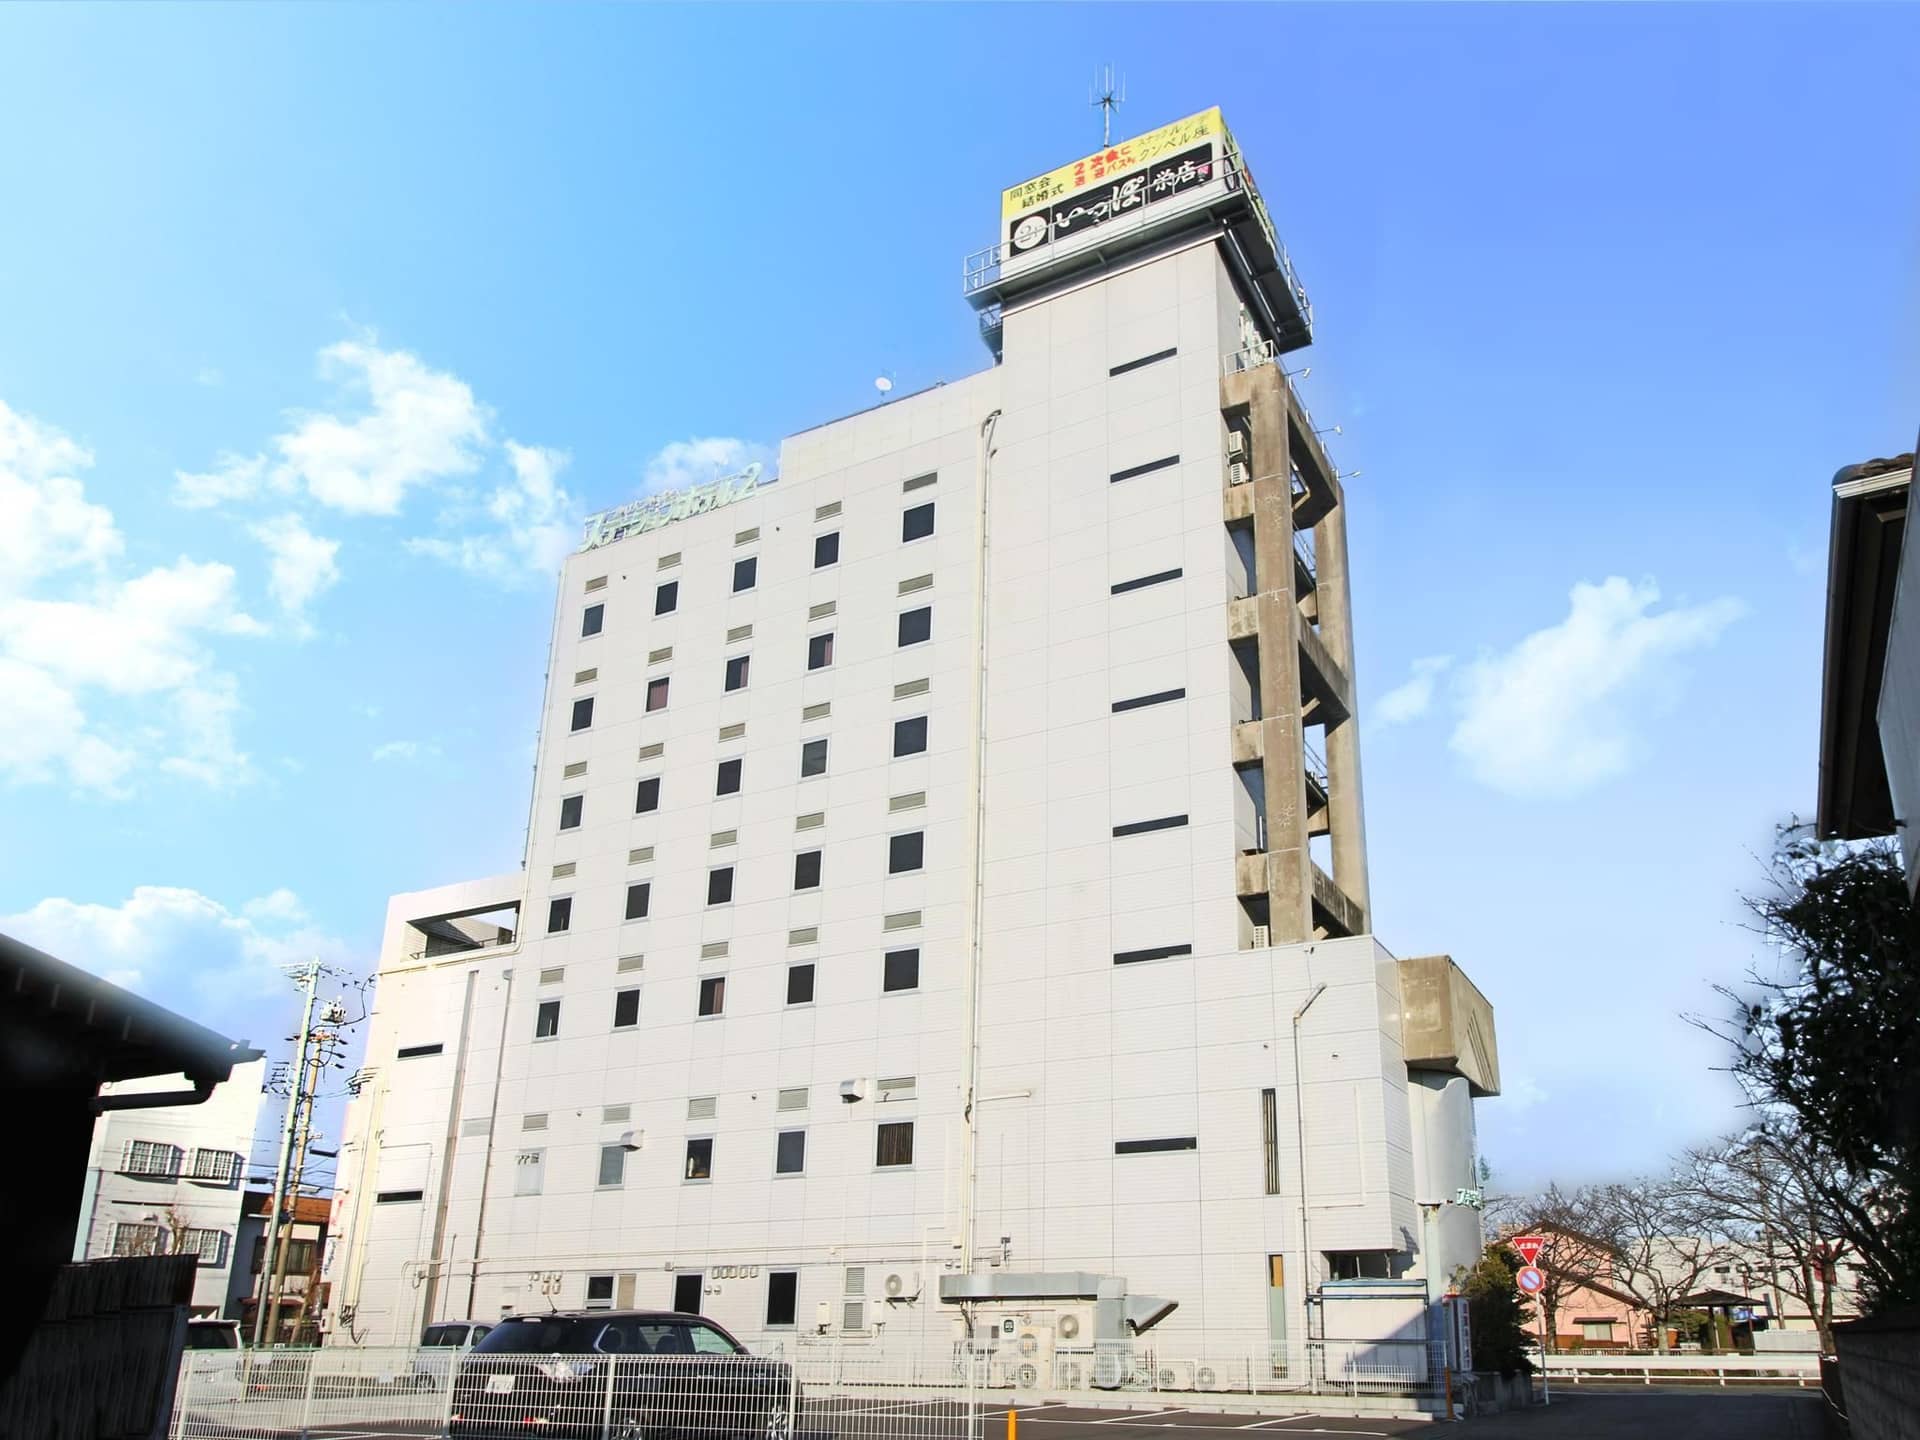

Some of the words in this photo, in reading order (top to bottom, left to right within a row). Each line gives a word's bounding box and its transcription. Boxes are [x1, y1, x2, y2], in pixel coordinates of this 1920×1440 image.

[1010, 177, 1051, 200] 同窓会
[1022, 183, 1064, 208] 結婚式
